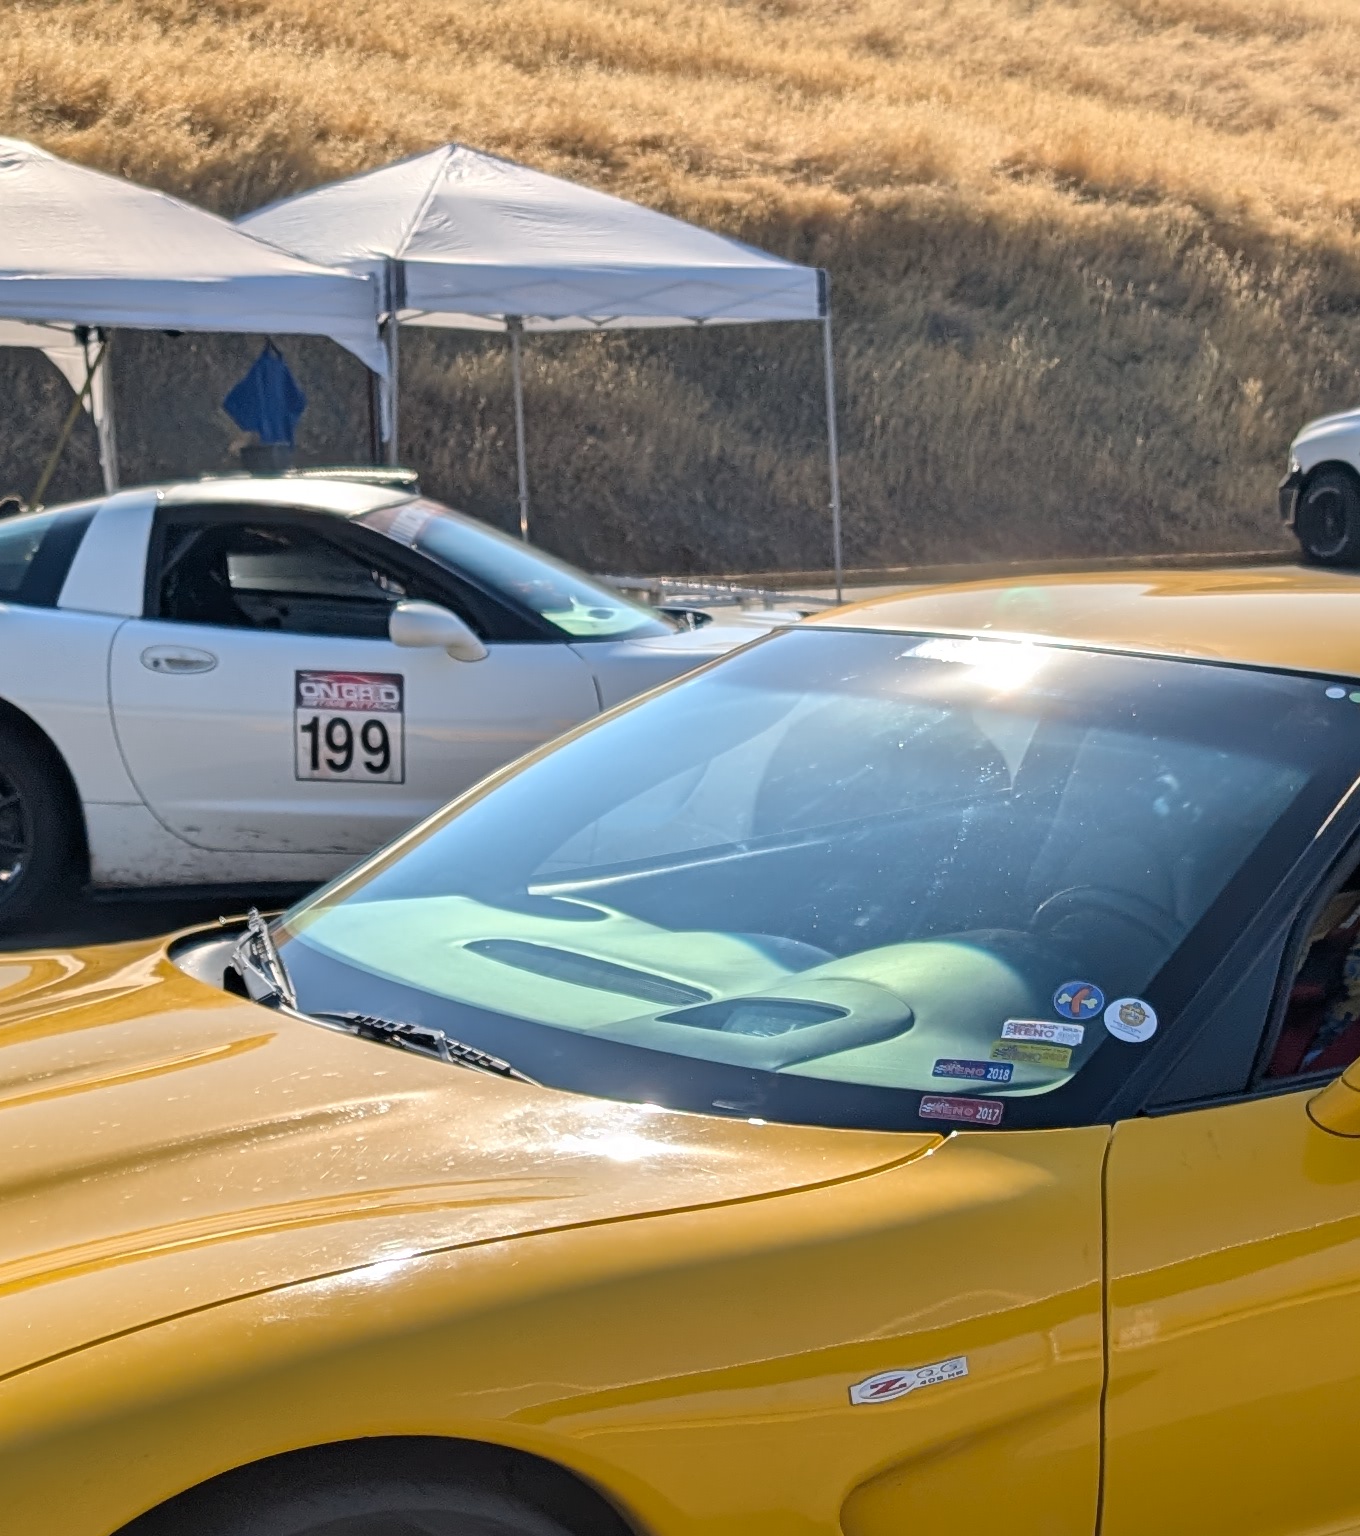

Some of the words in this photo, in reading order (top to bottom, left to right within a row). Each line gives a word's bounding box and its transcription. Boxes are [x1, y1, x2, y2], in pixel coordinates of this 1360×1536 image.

[300, 716, 391, 774] 199
[1013, 1026, 1055, 1039] RENO
[986, 1067, 1011, 1081] 2018
[976, 1106, 1000, 1121] 2017
